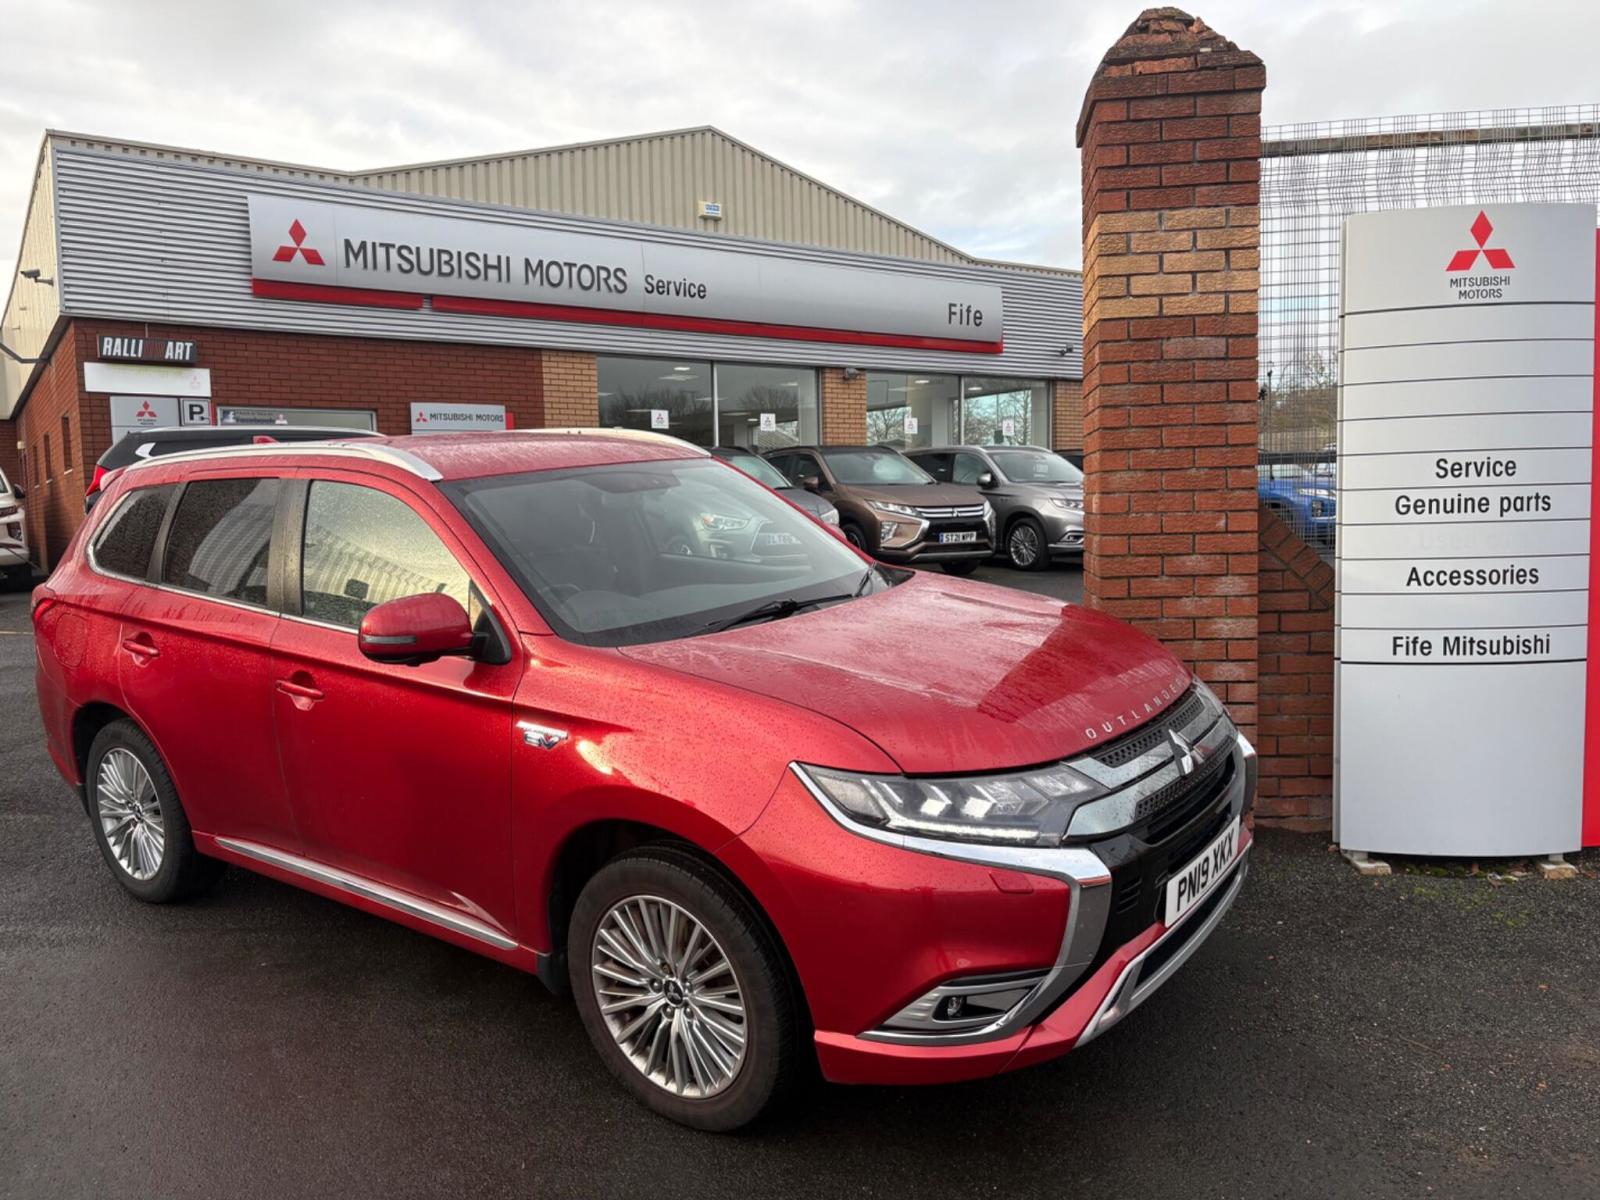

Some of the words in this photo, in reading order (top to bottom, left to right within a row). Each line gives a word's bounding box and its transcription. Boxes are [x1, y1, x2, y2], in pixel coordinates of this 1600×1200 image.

[343, 238, 511, 283] MITSUBISHI
[524, 257, 628, 294] MOTORS
[644, 273, 707, 299] Service
[1449, 275, 1511, 288] MITSUBISHI
[1458, 288, 1503, 300] MOTORS
[948, 302, 983, 327] Fife
[188, 404, 205, 421] P
[429, 412, 473, 422] MITSUBISHI
[475, 413, 504, 423] MOTORS
[1435, 456, 1517, 479] Service
[1395, 493, 1490, 515] Genuine
[1499, 492, 1552, 518] parts
[1406, 564, 1540, 587] Accessories
[1392, 635, 1433, 656] Fife
[1442, 633, 1550, 656] Mitsubishi
[1176, 855, 1210, 912] PN19
[1211, 828, 1234, 879] XKX
